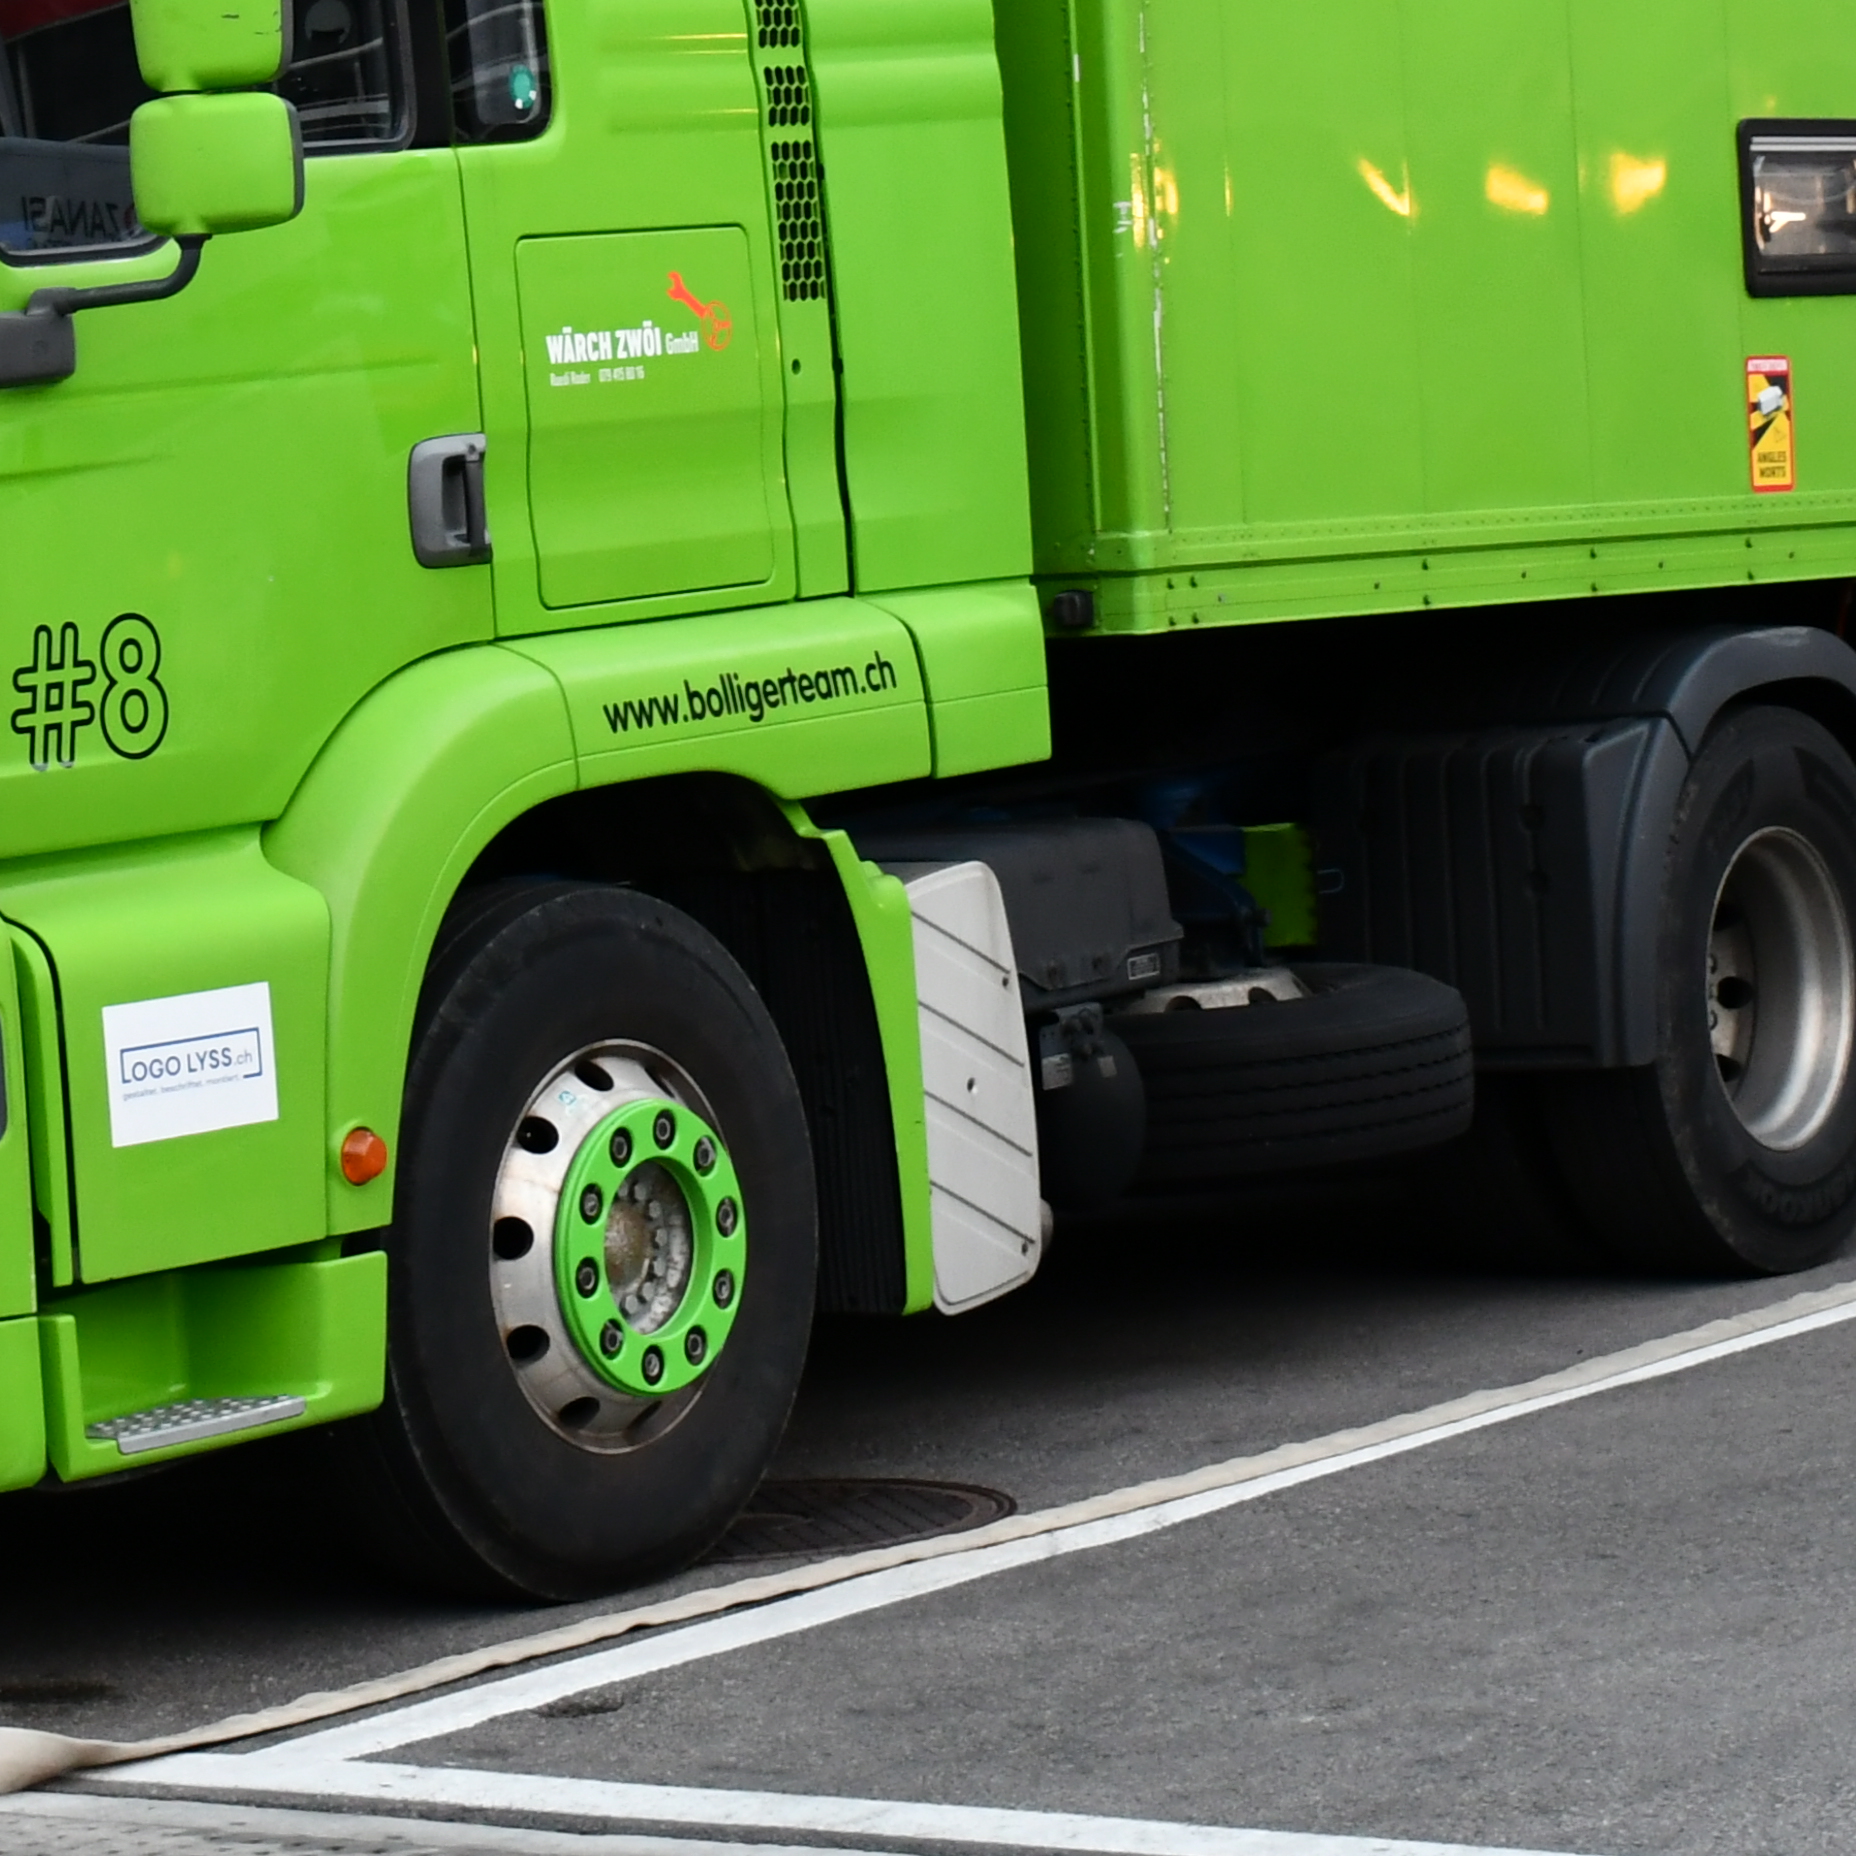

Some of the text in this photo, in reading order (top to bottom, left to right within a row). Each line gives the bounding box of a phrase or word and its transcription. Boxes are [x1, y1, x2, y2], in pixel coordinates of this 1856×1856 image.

[11, 612, 169, 772] #8
[603, 651, 897, 734] www.bolligerteam.ch
[120, 1052, 181, 1084] LOGO
